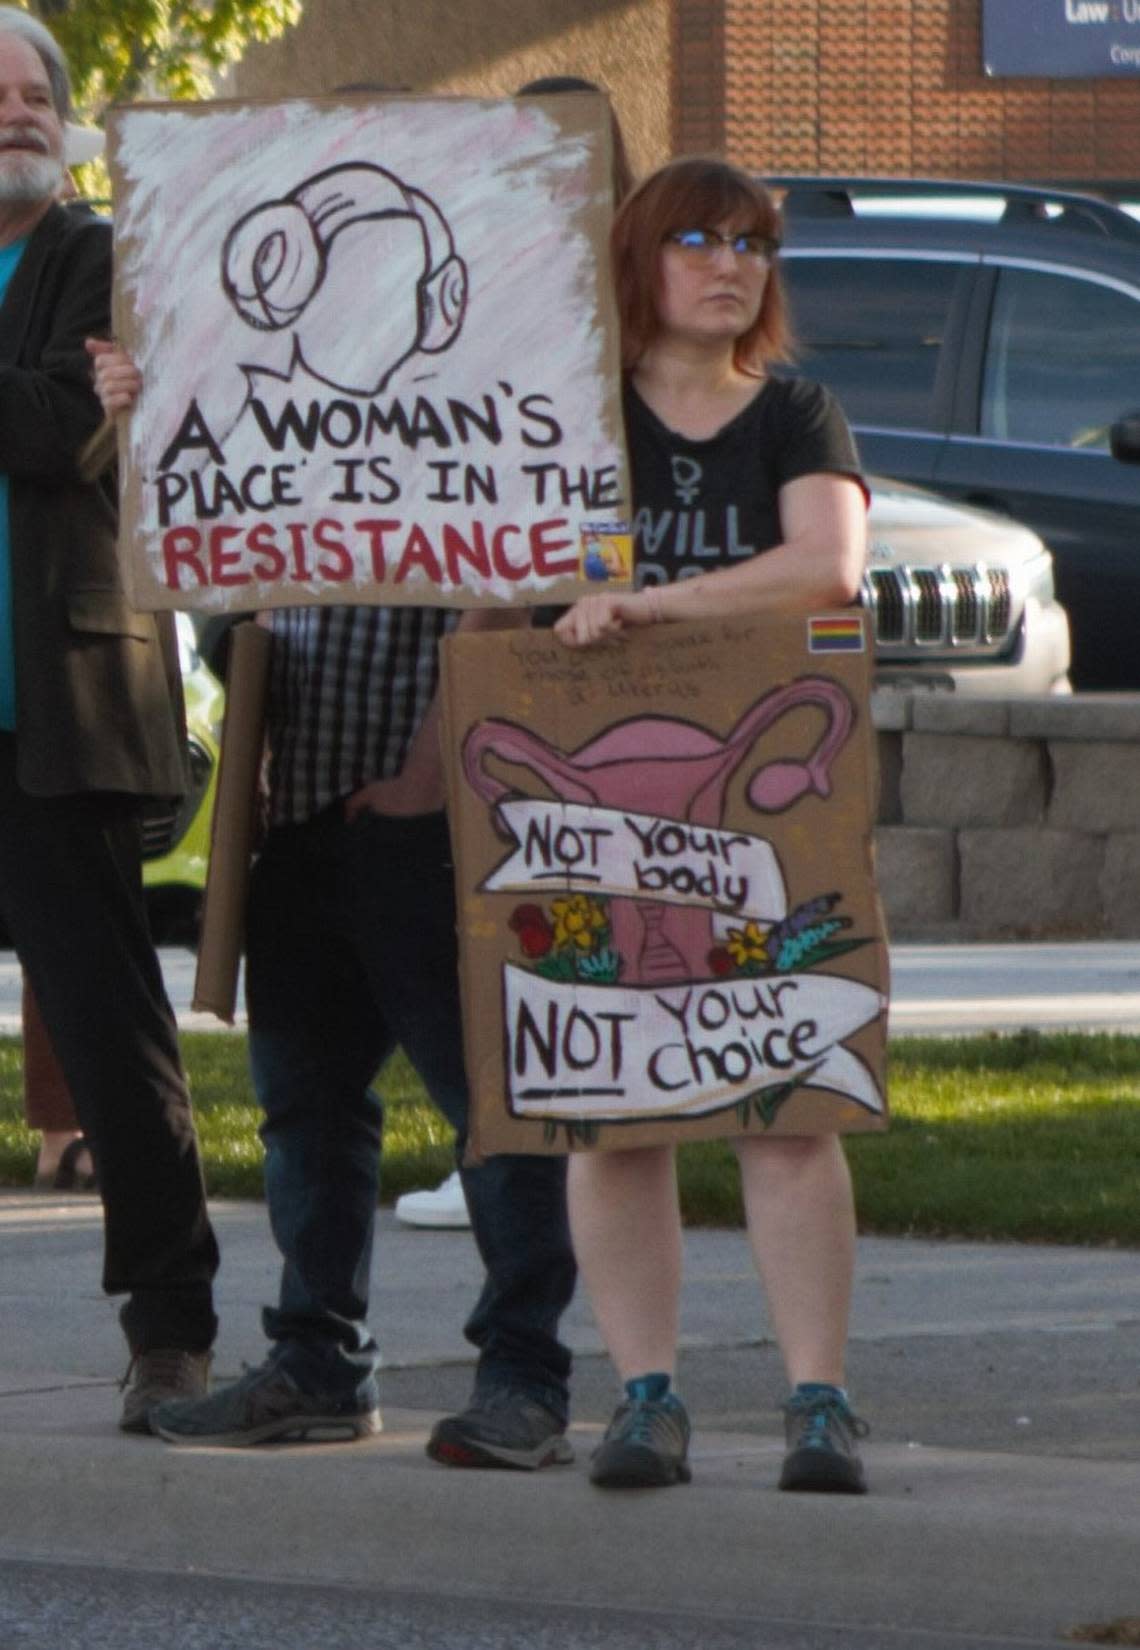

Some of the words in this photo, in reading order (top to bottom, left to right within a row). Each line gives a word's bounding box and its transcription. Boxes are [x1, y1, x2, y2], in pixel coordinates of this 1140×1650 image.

[158, 398, 226, 470] A
[250, 383, 562, 452] WOMAN'S
[329, 456, 400, 504] IS
[425, 461, 498, 504] IN
[521, 462, 622, 511] THE
[161, 519, 580, 590] RESISTANCE
[524, 814, 614, 868] NOT
[632, 859, 750, 914] body
[514, 996, 638, 1082] NOT
